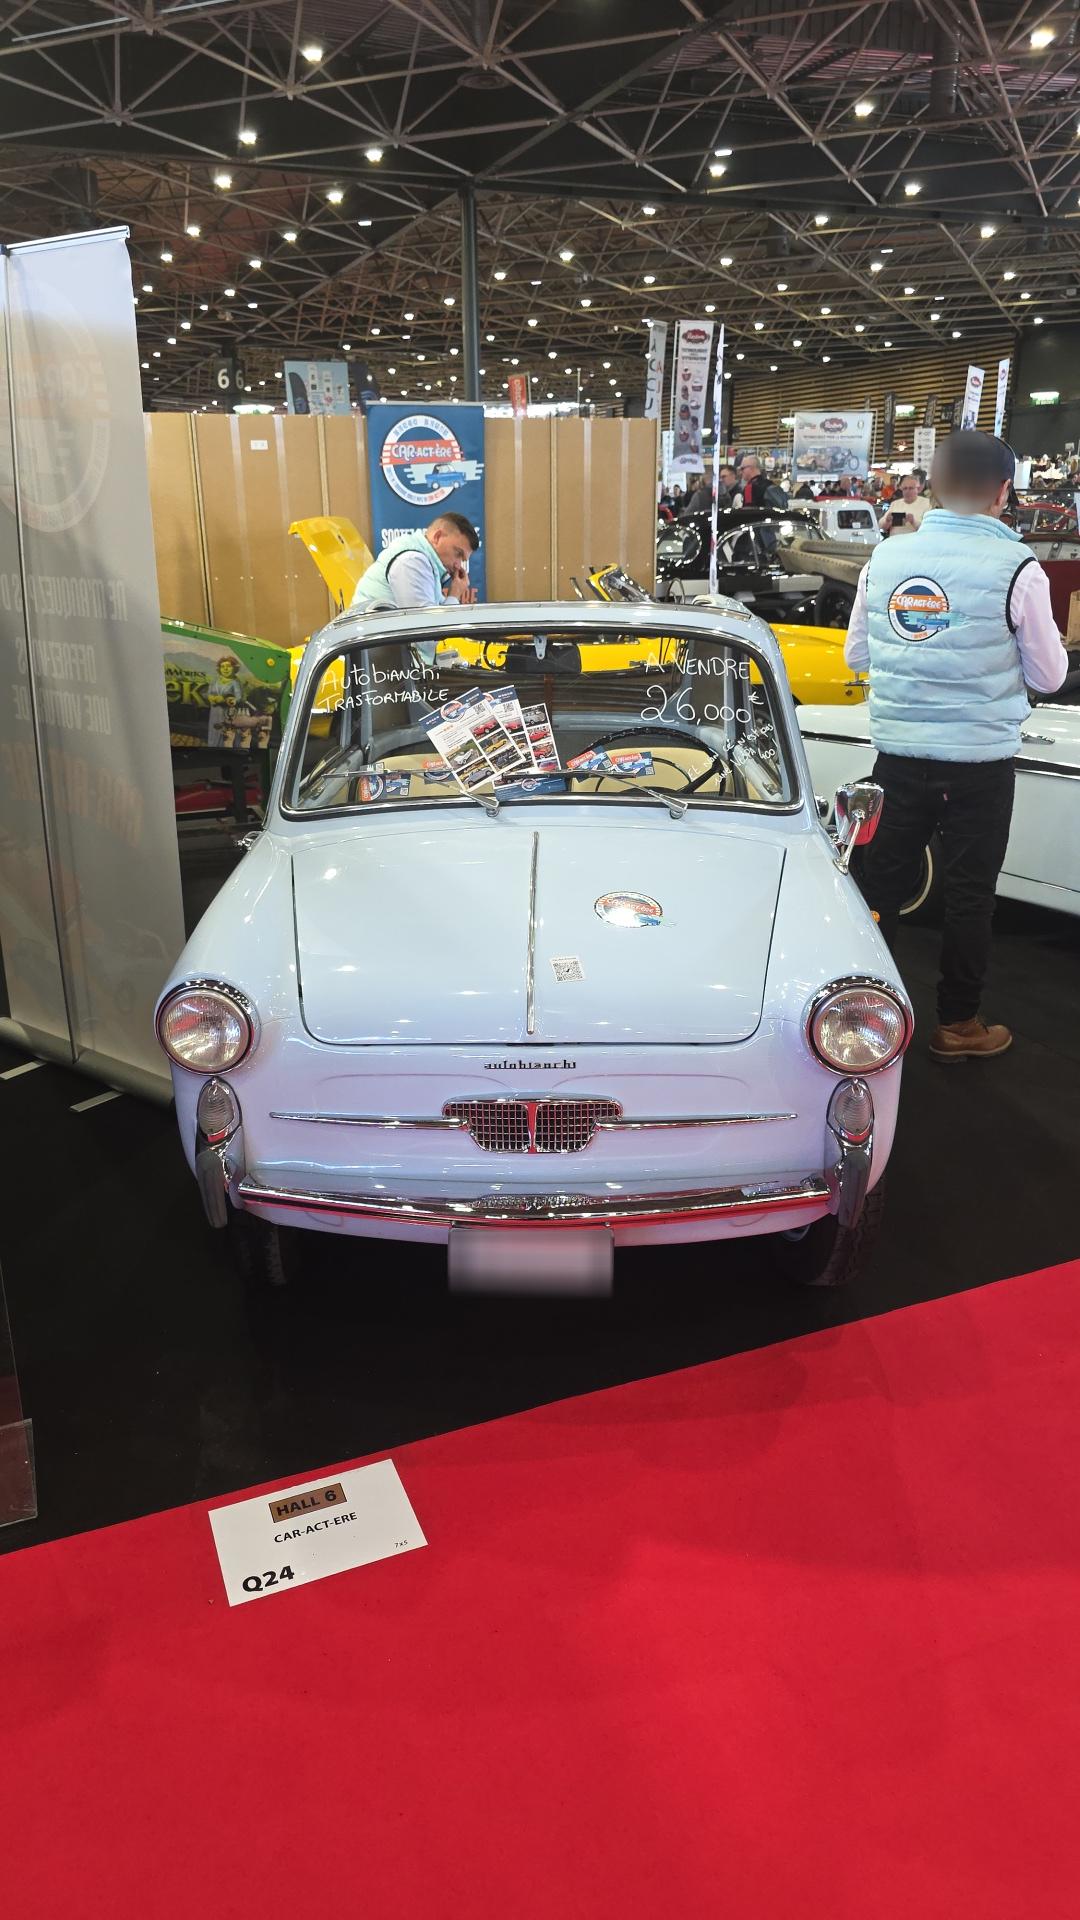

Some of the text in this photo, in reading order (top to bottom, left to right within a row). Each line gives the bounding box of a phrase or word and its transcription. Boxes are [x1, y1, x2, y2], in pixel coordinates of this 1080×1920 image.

[217, 368, 230, 390] 6
[235, 369, 244, 389] 6
[644, 649, 751, 680] A VENDRE
[484, 1060, 577, 1070] autobianchi
[276, 1490, 336, 1517] HALL 6
[274, 1511, 358, 1543] CAR-ACT-ERE
[242, 1565, 295, 1593] Q24
